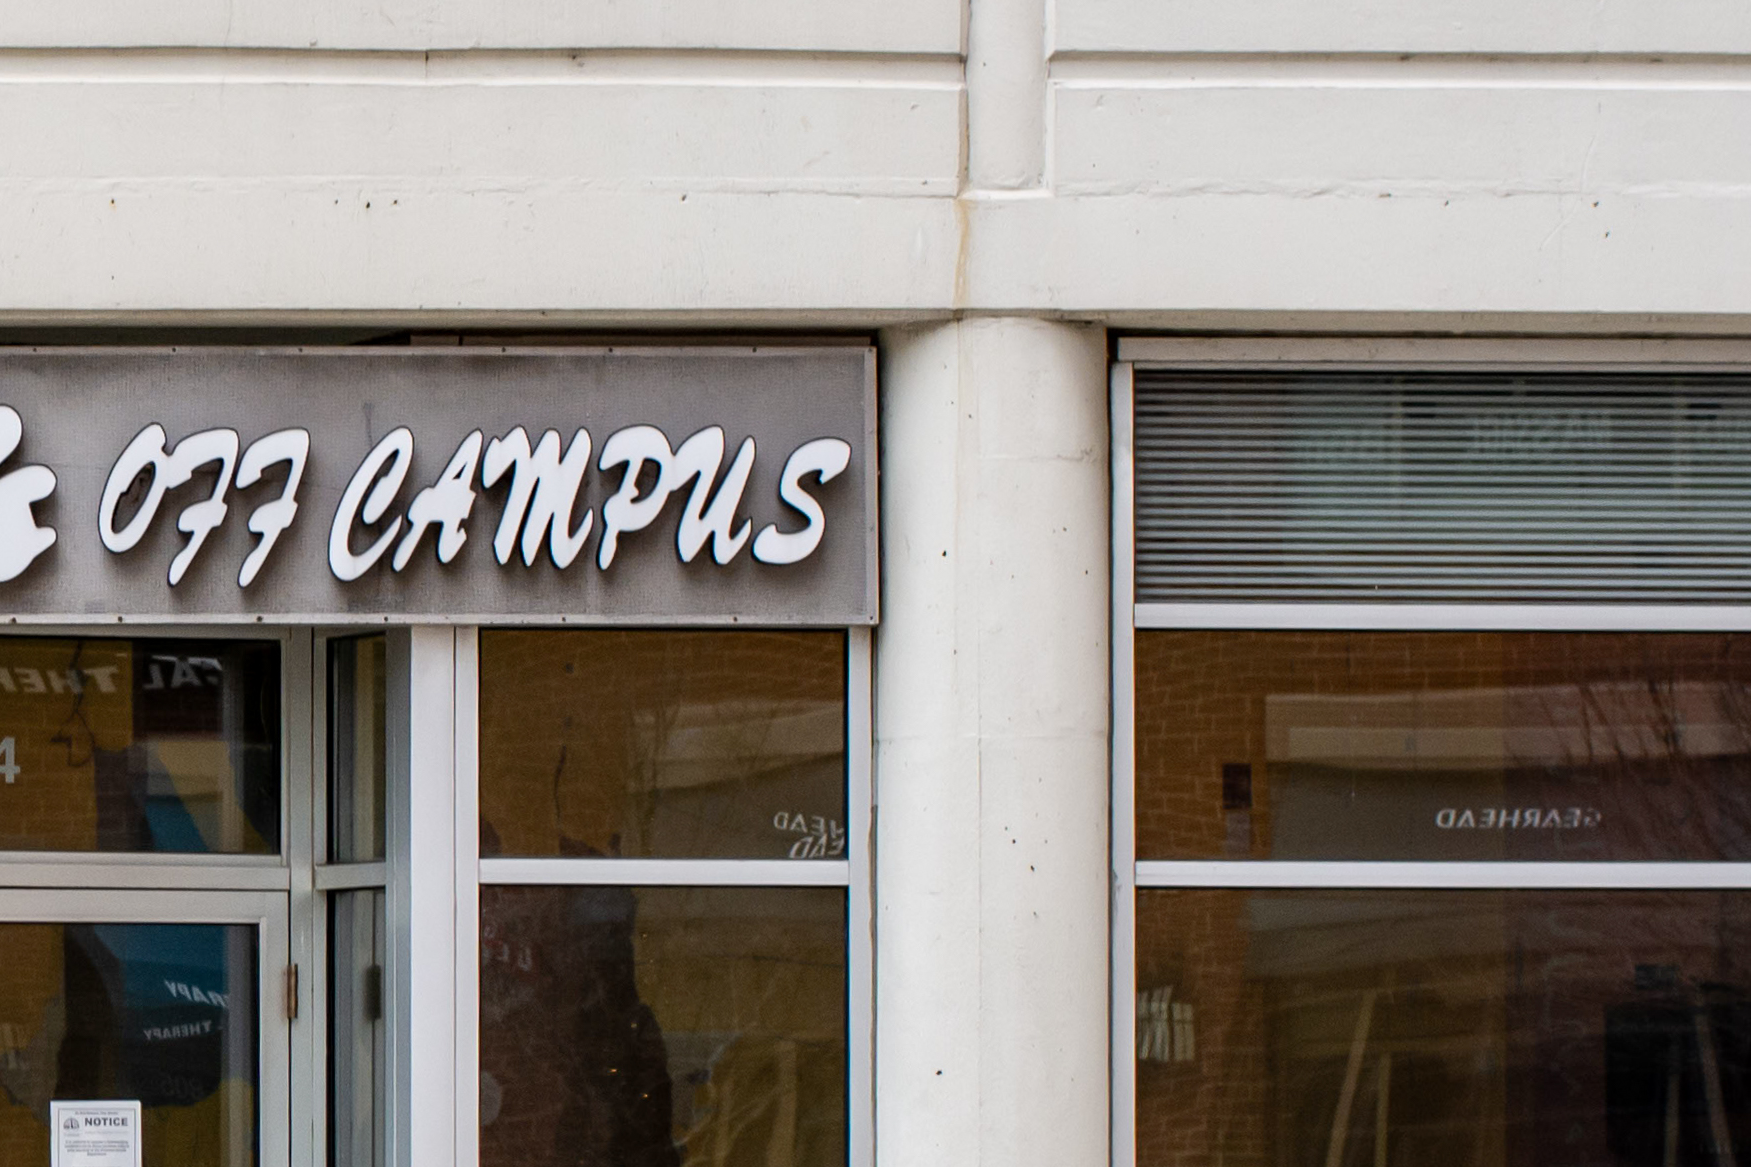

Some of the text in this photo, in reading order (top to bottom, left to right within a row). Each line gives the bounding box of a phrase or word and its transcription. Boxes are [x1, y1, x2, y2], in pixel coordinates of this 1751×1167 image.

[97, 422, 311, 588] OFF
[327, 424, 852, 584] CAMPUS
[84, 1117, 128, 1127] NOTICE
